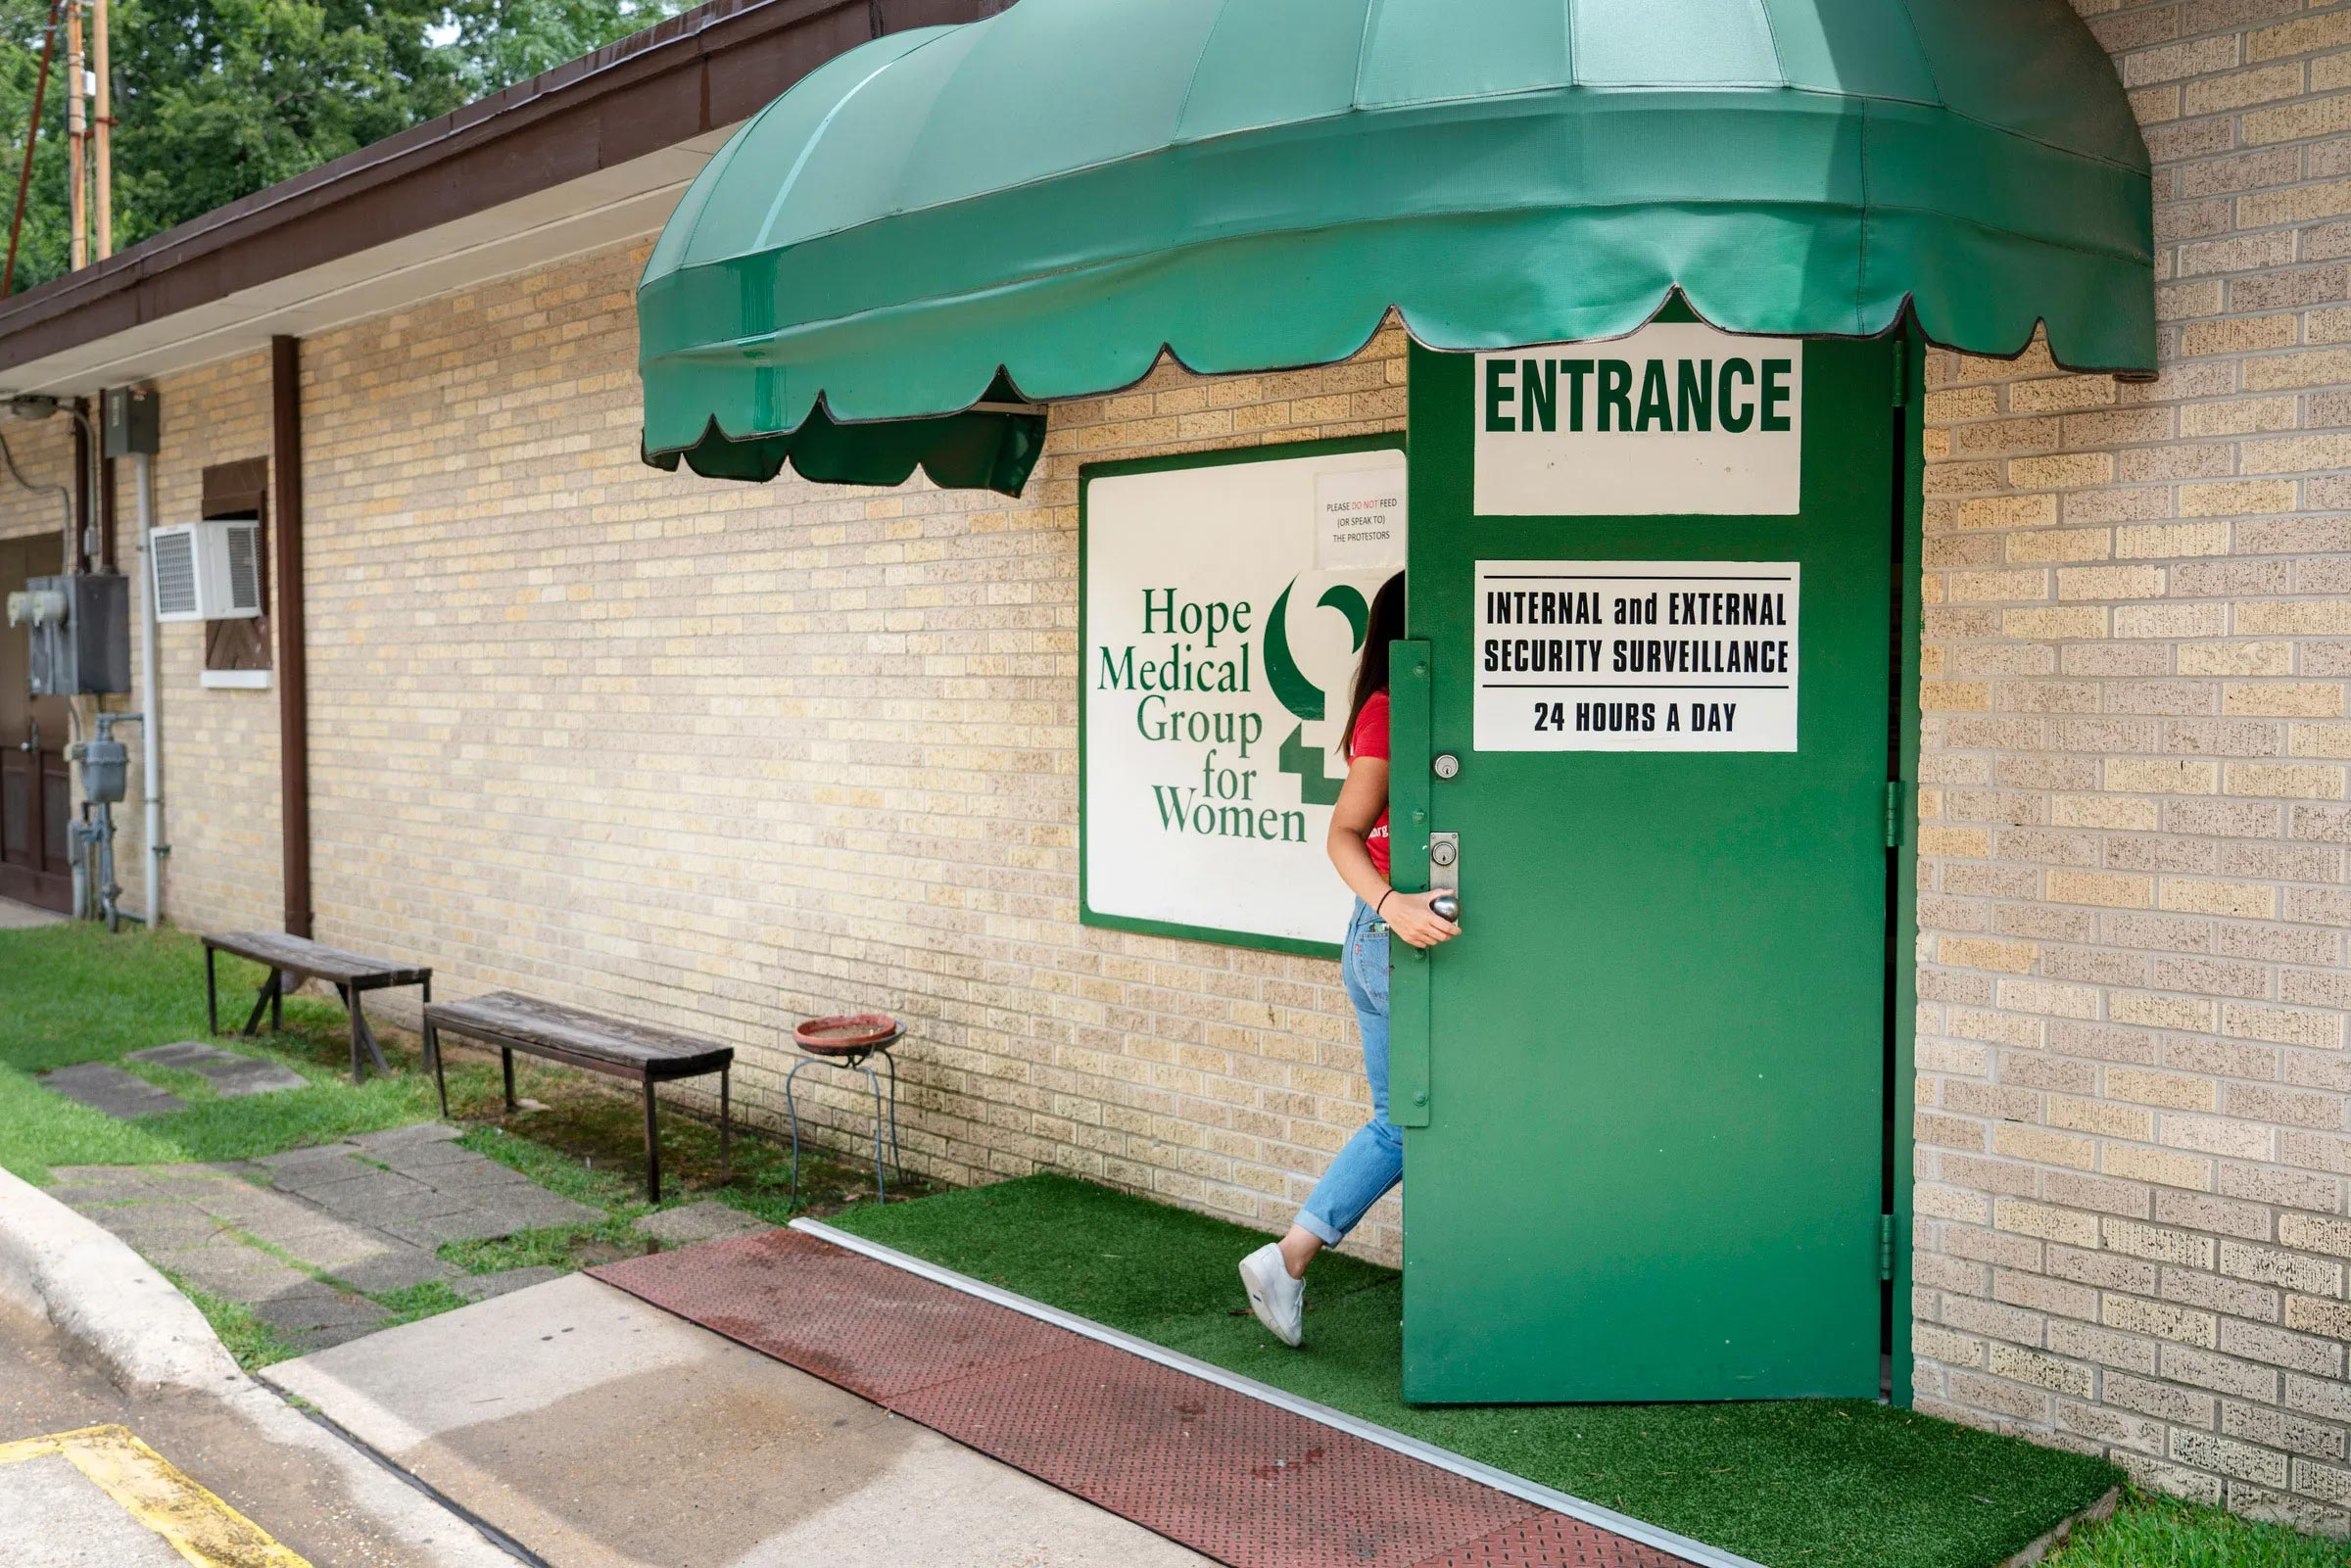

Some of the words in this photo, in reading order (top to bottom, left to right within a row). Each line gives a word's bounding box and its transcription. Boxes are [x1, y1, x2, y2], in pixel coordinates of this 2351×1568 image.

[1485, 357, 1792, 433] ENTRANCE
[1326, 502, 1350, 512] PLEASE
[1364, 499, 1378, 509] NOT
[1379, 498, 1398, 507] FEED
[1337, 518, 1350, 528] (OR
[1351, 516, 1371, 526] SPEAK
[1373, 515, 1386, 525] TO)
[1333, 534, 1346, 543] THE
[1347, 531, 1390, 542] PROTESTORS
[1141, 588, 1252, 648] Hope
[1486, 592, 1603, 625] INTERNAL
[1613, 593, 1657, 625] and
[1668, 593, 1787, 626] EXTERNAL
[1096, 642, 1252, 692] Medical
[1484, 640, 1603, 673] SECURITY
[1612, 640, 1789, 673] SURVEILLANCE
[1136, 693, 1263, 759] Group
[1534, 702, 1565, 732] 24
[1575, 703, 1655, 732] HOURS
[1666, 703, 1680, 732] A
[1691, 703, 1737, 733] DAY
[1203, 748, 1258, 800] for
[1151, 784, 1308, 843] Women
